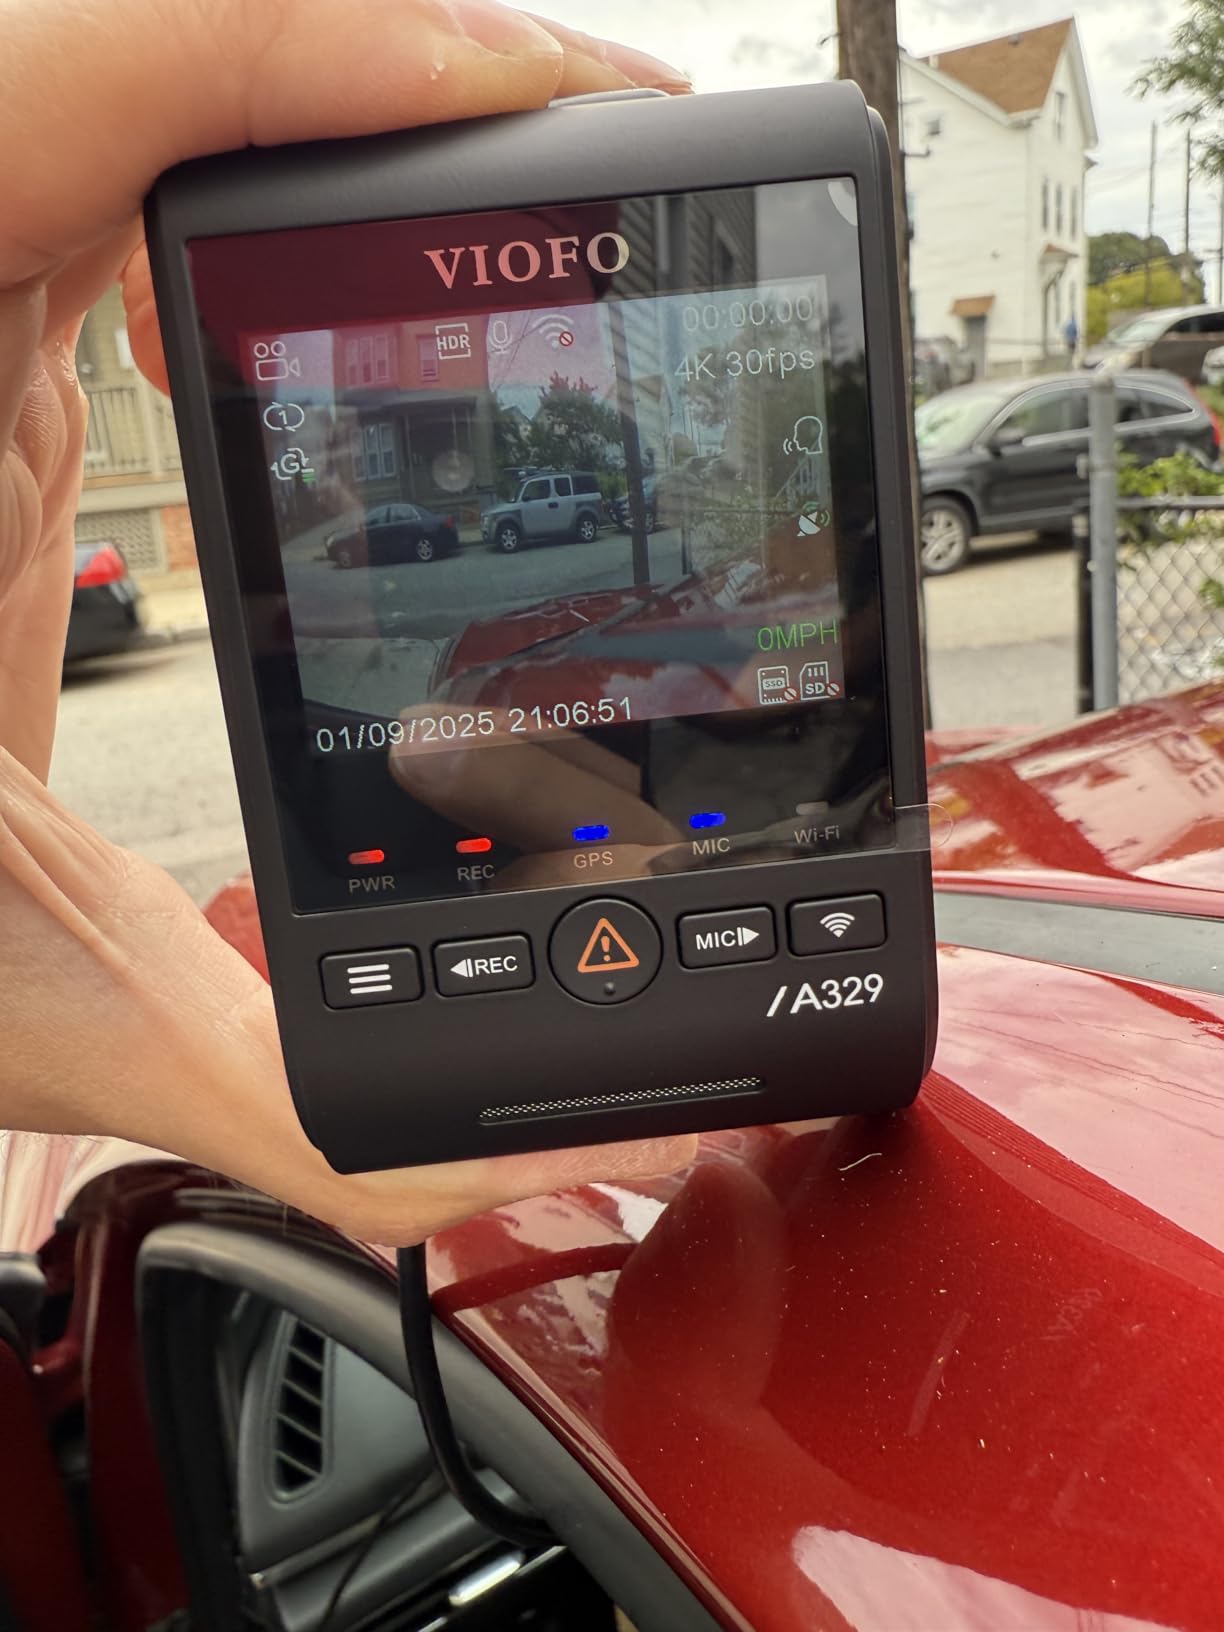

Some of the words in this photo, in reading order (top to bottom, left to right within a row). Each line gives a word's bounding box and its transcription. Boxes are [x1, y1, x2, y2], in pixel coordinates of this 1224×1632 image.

[423, 231, 630, 289] VIOFO
[436, 334, 471, 351] HDR
[674, 352, 717, 382] 4K
[726, 346, 816, 380] 30fps
[805, 681, 826, 696] SD
[316, 711, 495, 752] 01/09/2025
[508, 697, 632, 732] 21:06:51
[794, 825, 841, 844] Wi-Fi
[692, 837, 731, 856] MIC
[573, 851, 614, 868] GPS
[457, 864, 496, 881] REC
[349, 874, 396, 893] PWR
[695, 928, 737, 950] MIC
[474, 955, 518, 976] REC
